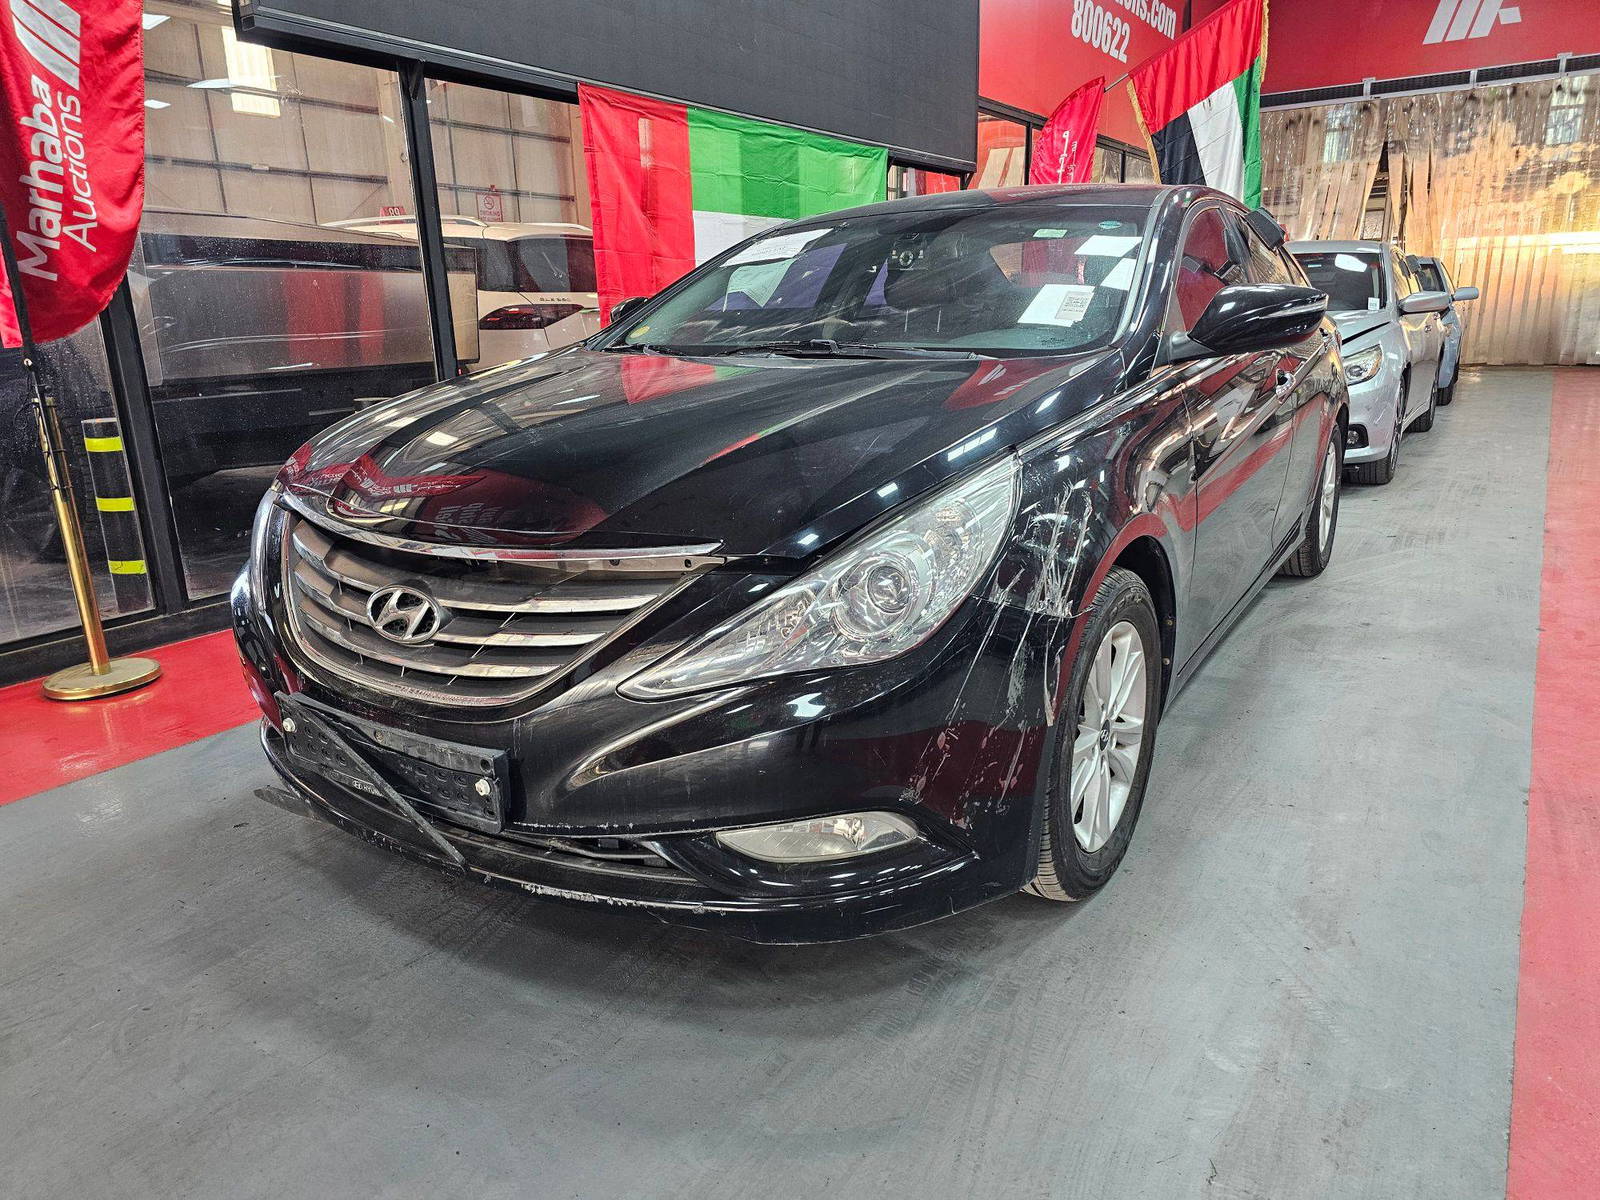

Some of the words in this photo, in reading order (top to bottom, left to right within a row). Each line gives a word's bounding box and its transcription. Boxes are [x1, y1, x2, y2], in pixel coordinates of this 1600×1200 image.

[1071, 0, 1131, 64] 800622
[1115, 0, 1176, 40] ns.com
[16, 74, 64, 282] Marhaba
[57, 91, 98, 253] Auctions
